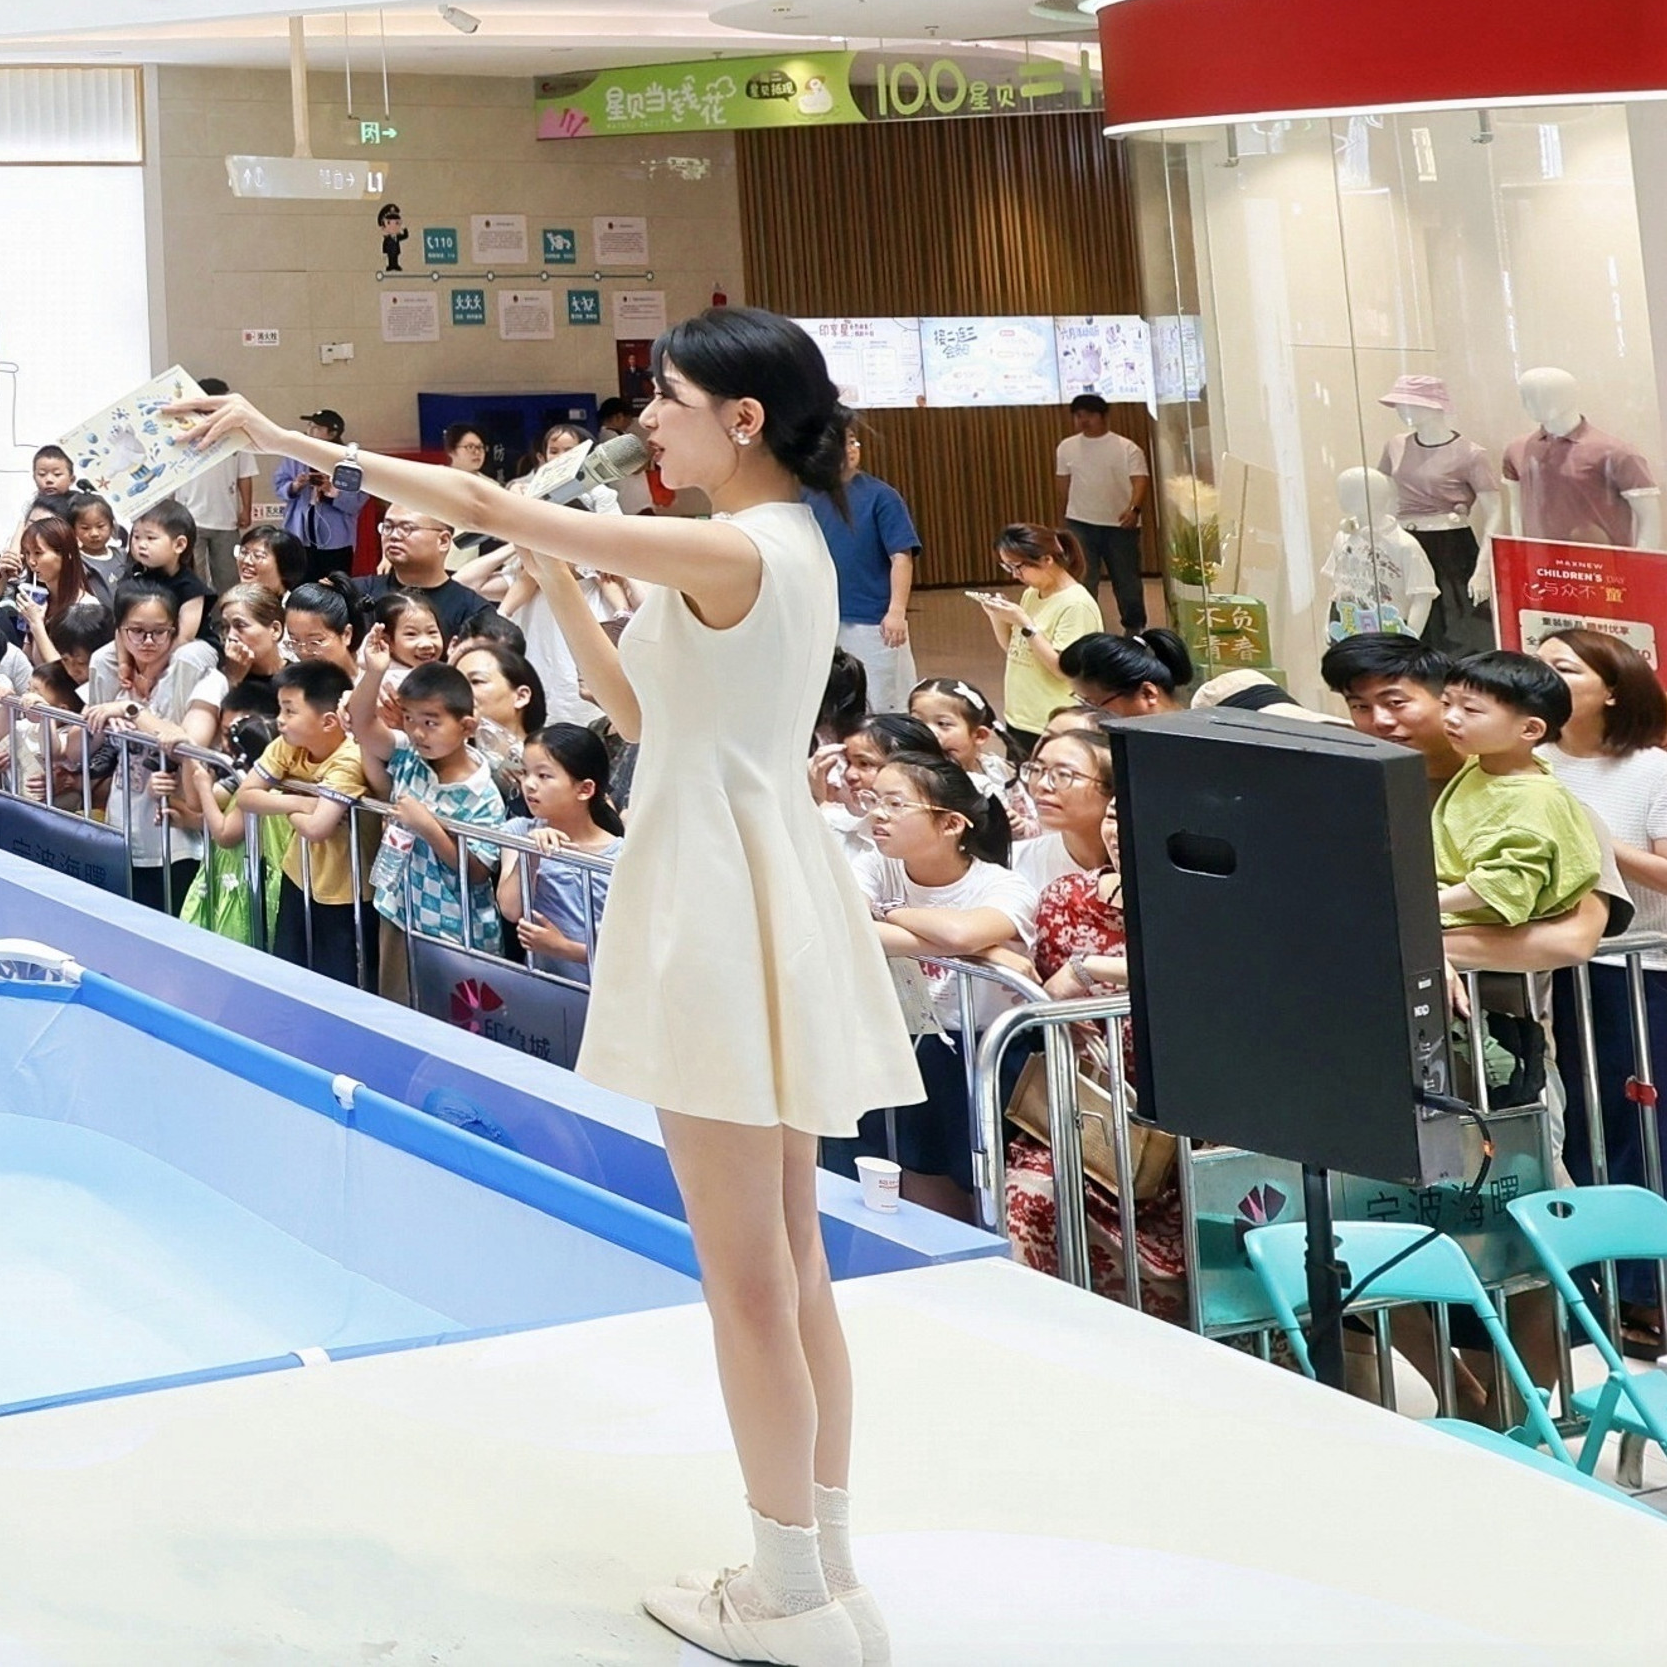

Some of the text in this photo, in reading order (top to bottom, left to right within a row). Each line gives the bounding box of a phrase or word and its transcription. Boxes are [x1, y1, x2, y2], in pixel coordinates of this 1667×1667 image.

[367, 171, 384, 194] L1
[434, 238, 454, 250] 110
[1555, 558, 1605, 570] MAXNEW
[1536, 567, 1603, 584] CHILDREN'S
[1194, 605, 1260, 634] 不负
[1192, 633, 1262, 662] 青春
